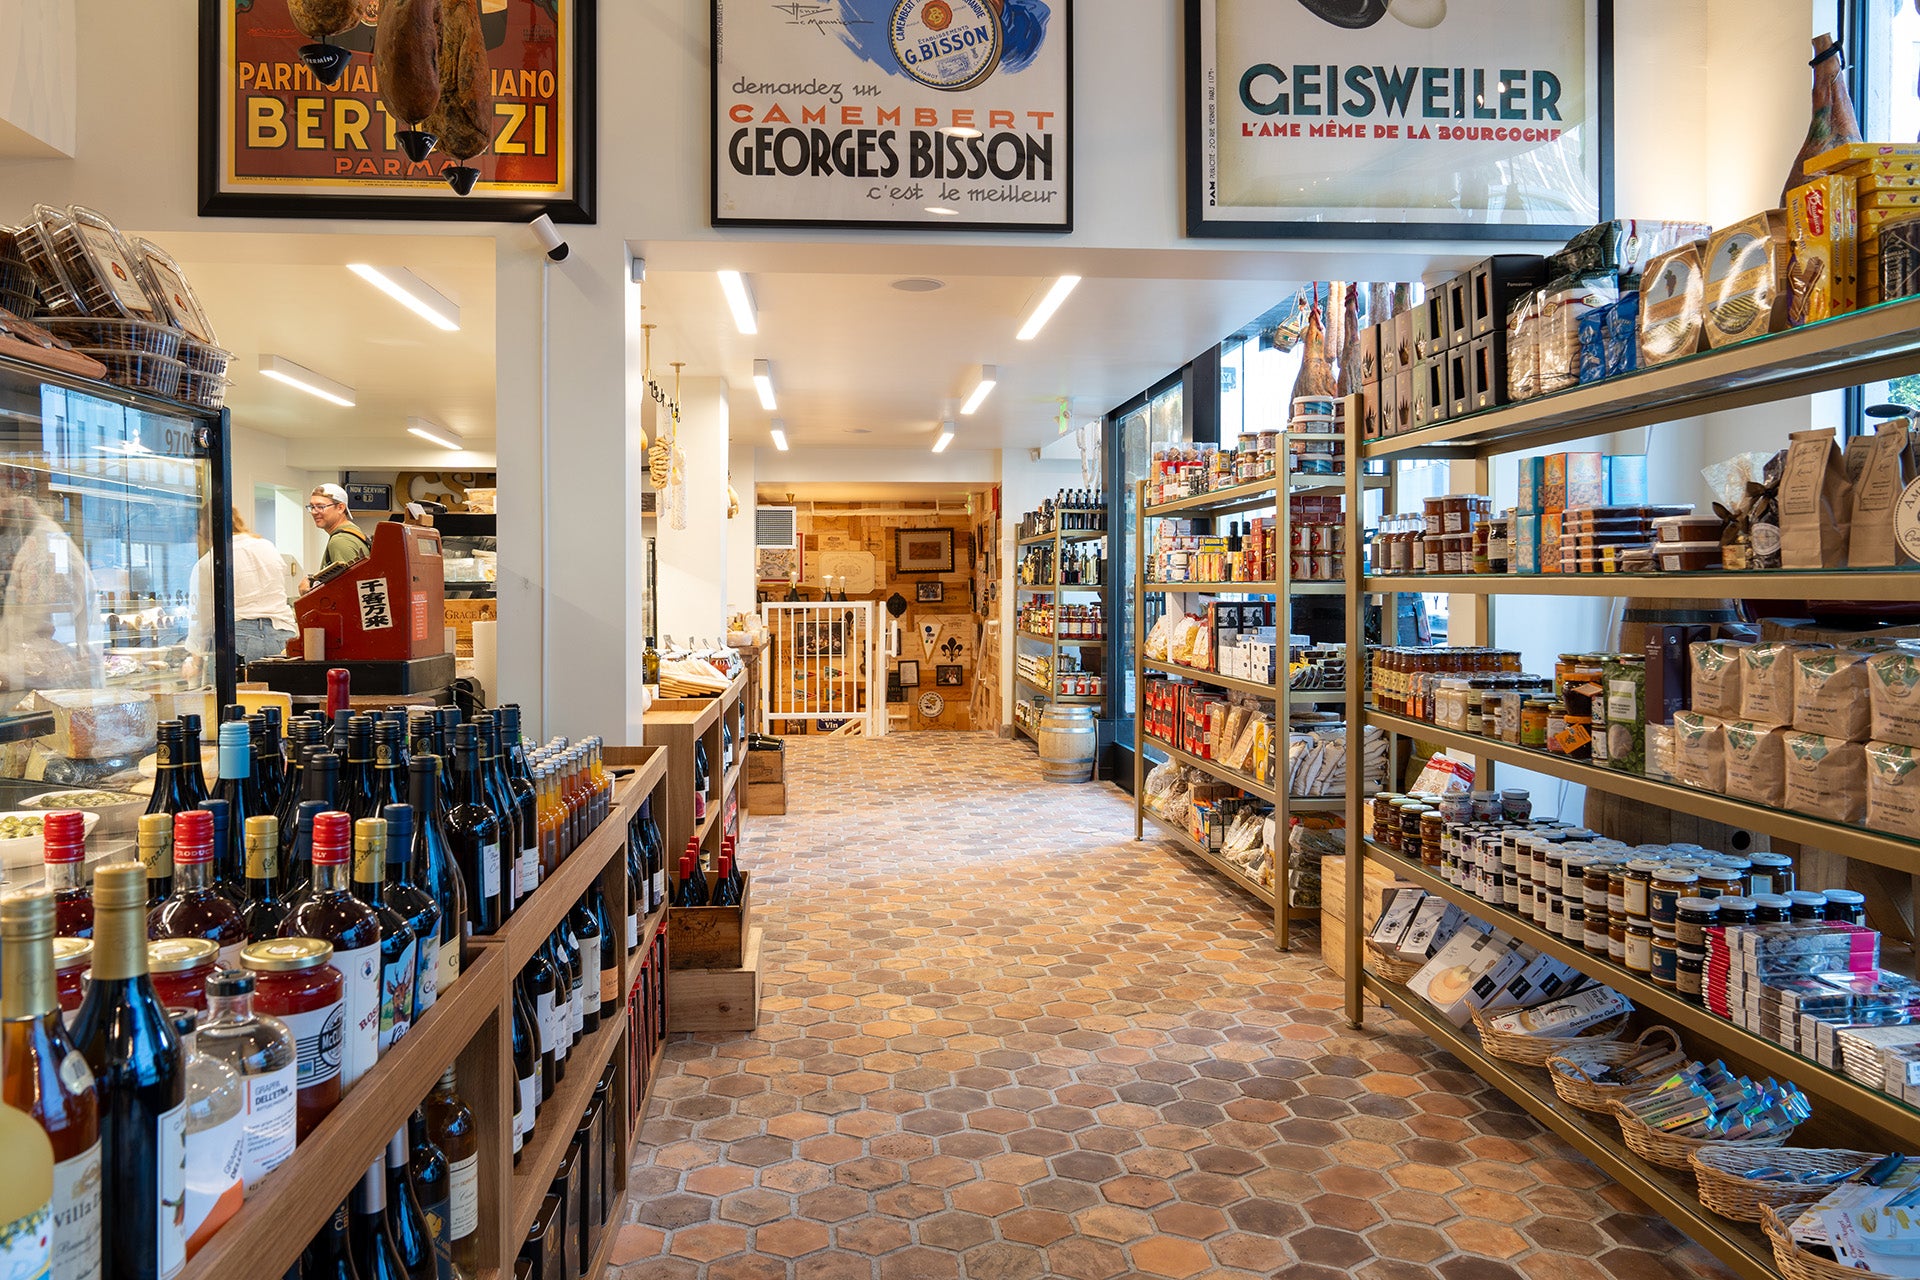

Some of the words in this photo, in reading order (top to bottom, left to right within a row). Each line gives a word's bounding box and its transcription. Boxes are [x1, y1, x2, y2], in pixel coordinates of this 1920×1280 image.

[904, 24, 990, 65] G.BISSON
[731, 76, 844, 105] demandez
[852, 83, 882, 98] un
[1239, 63, 1563, 122] GEISWEILER
[729, 102, 1055, 131] CAMEMBERT
[1242, 121, 1301, 138] L'AME
[1309, 119, 1367, 139] MÊME
[1374, 124, 1399, 139] DE
[1407, 125, 1432, 140] LA
[1437, 125, 1562, 143] BOURGOGNE
[728, 127, 900, 179] GEORGES
[909, 130, 1054, 181] BISSON
[866, 184, 925, 201] c'est
[939, 182, 961, 201] le
[967, 185, 1058, 205] meilleur
[362, 486, 387, 494] SERVING
[359, 579, 390, 628] 千客万来
[444, 609, 478, 620] GRACE
[824, 721, 839, 729] Vin
[54, 1200, 92, 1229] Villa
